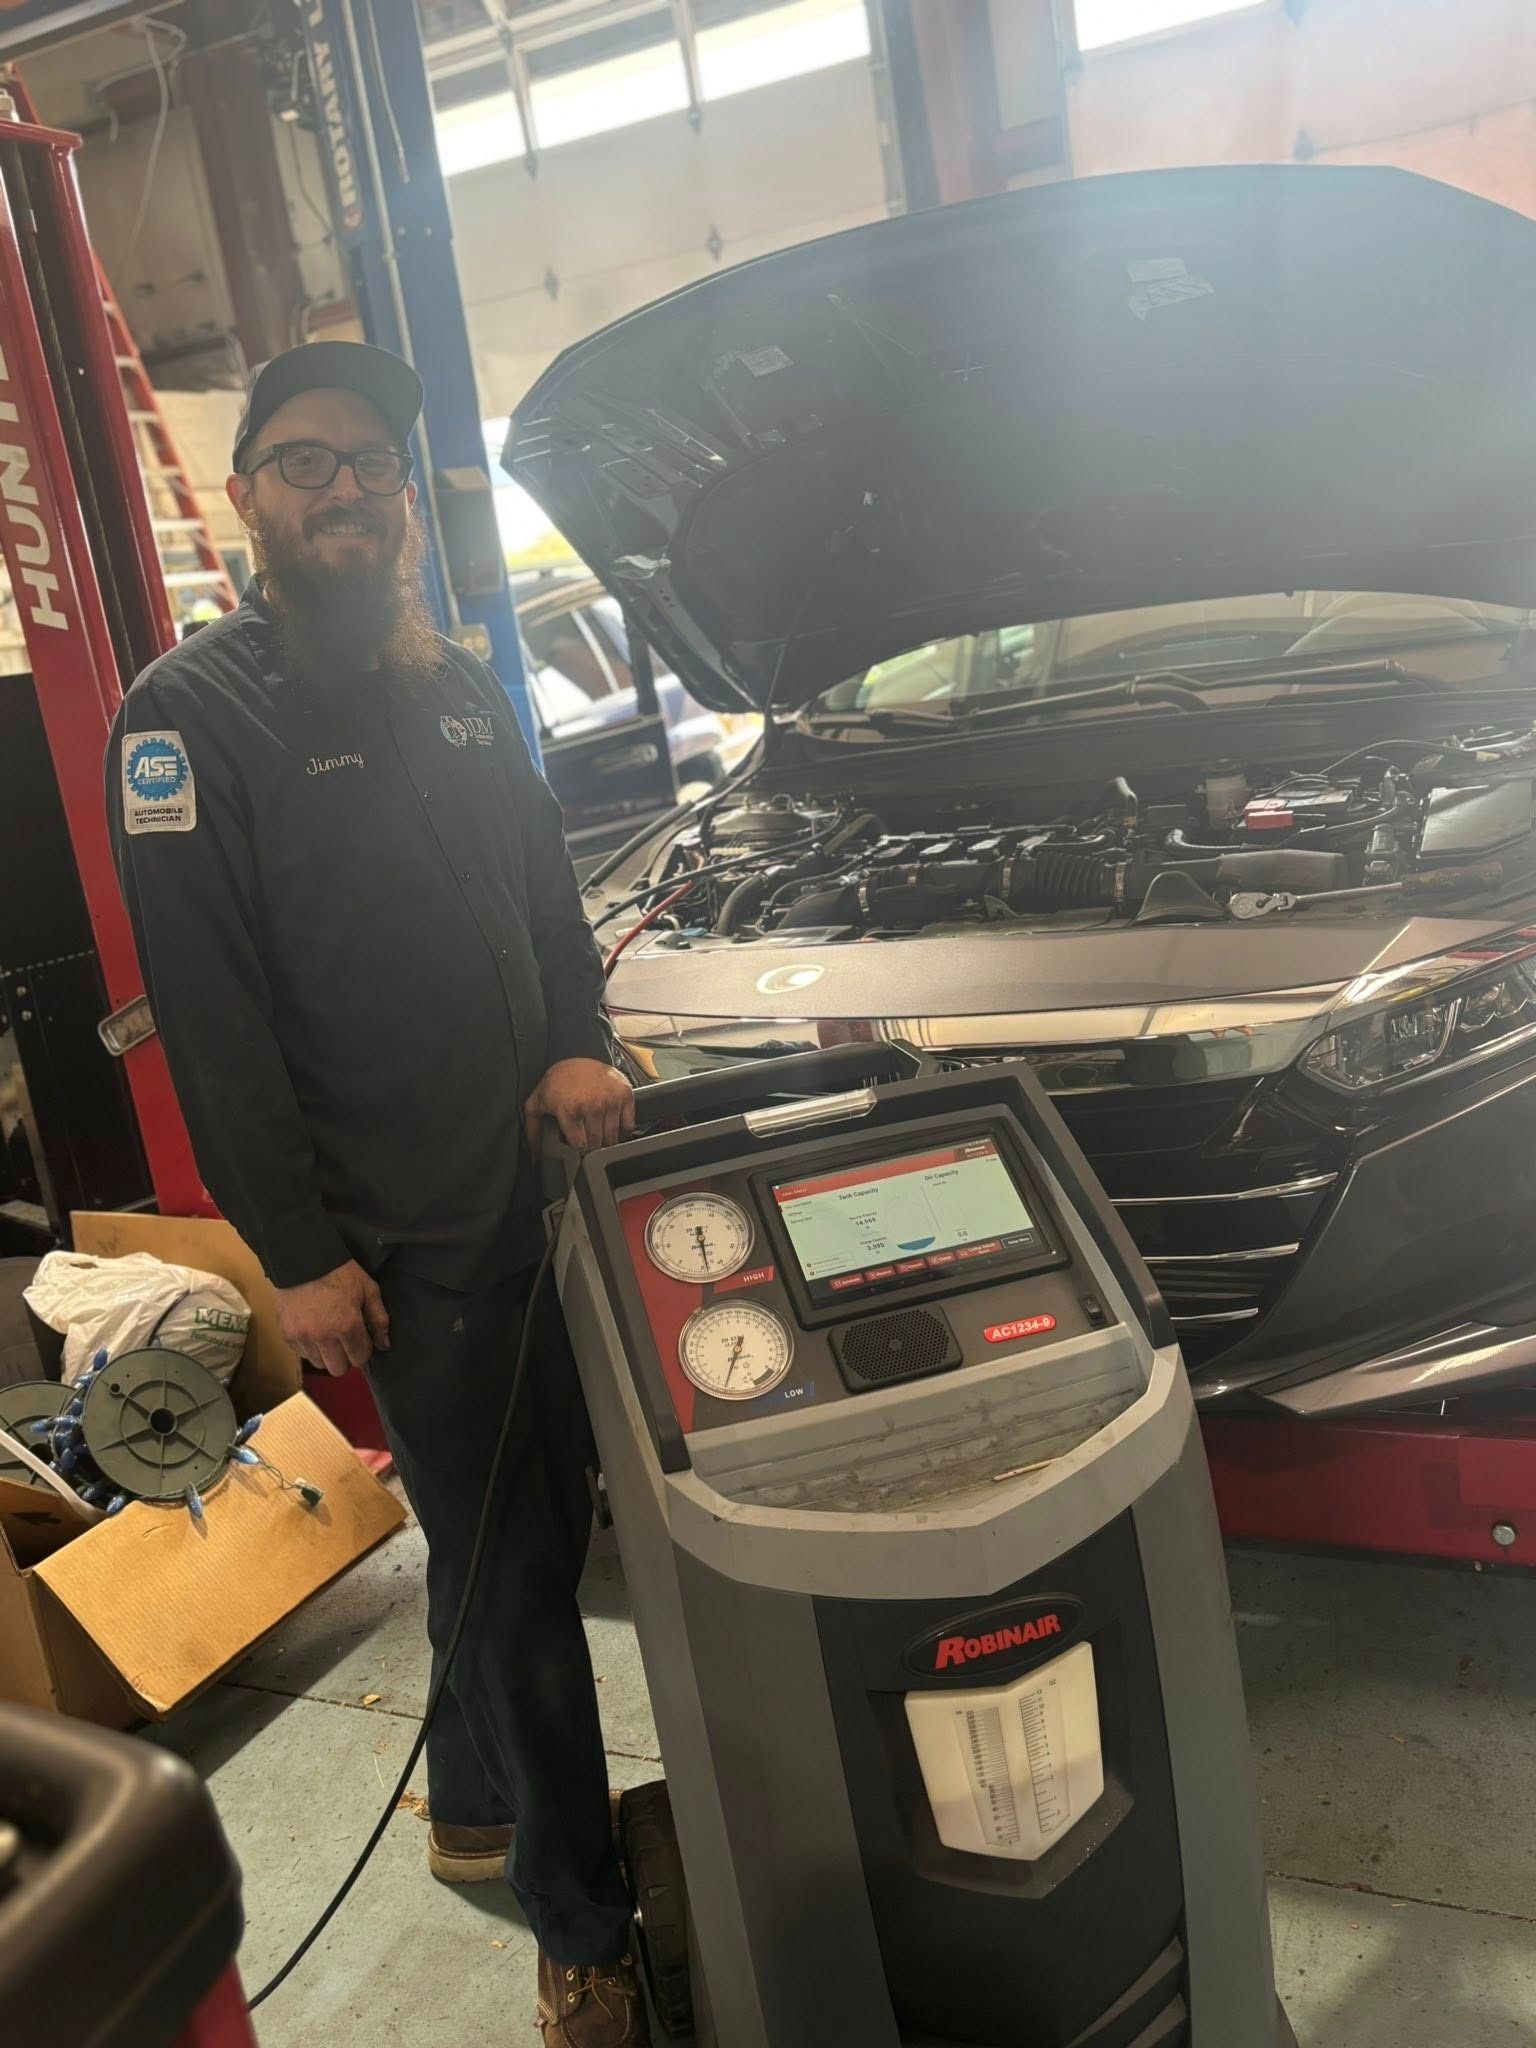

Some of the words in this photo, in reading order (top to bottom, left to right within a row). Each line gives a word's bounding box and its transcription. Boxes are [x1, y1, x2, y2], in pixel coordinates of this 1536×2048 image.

[133, 755, 178, 779] ASE
[306, 752, 364, 775] Jimmy
[134, 807, 183, 817] AUTOMOBILE
[135, 815, 182, 825] TECHNICIAN
[743, 1272, 765, 1283] HIGH
[992, 1317, 1051, 1340] AC1234-9
[784, 1388, 804, 1399] LOW
